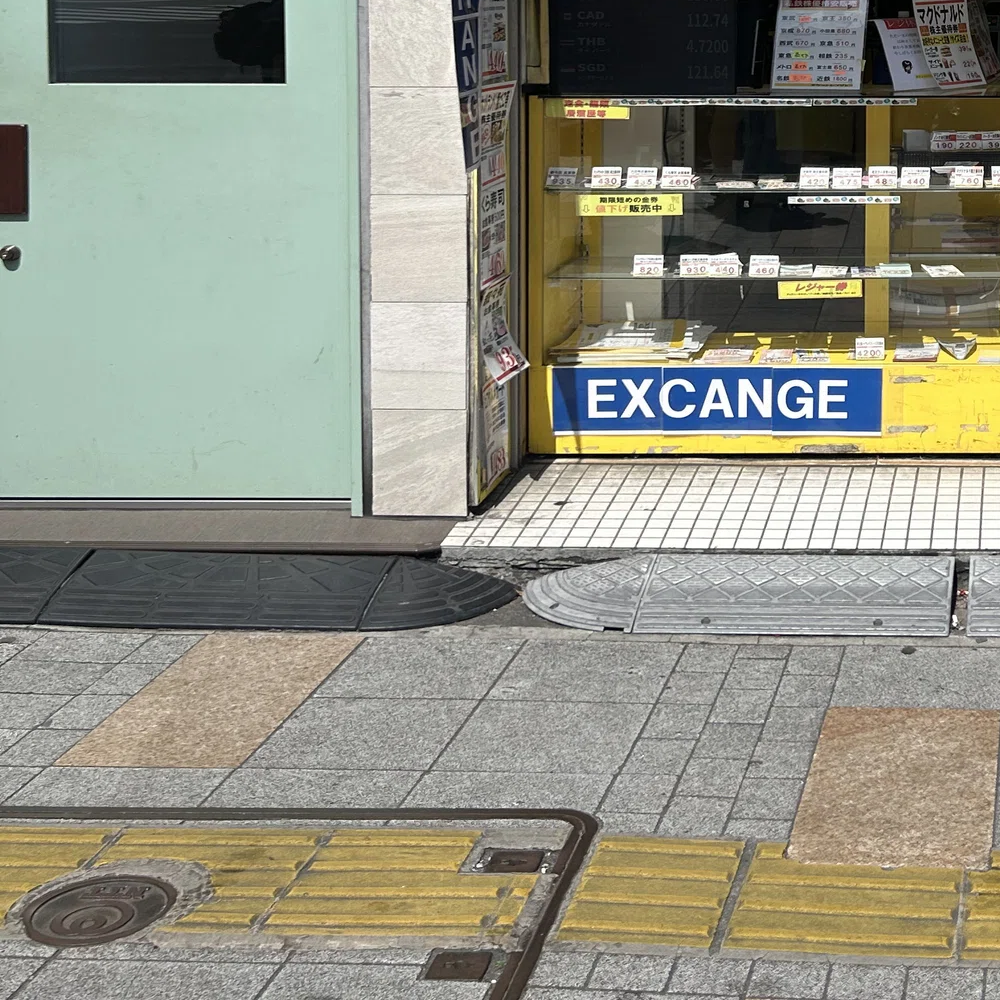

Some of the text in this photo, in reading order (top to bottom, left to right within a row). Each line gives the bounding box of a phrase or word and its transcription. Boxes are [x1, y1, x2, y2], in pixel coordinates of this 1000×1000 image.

[577, 11, 605, 20] CAD
[917, 4, 964, 25] マクドナルド
[577, 37, 606, 46] THB
[577, 64, 606, 72] SGD
[596, 204, 662, 213] 値下げ販売中
[587, 377, 848, 420] EXCANGE
